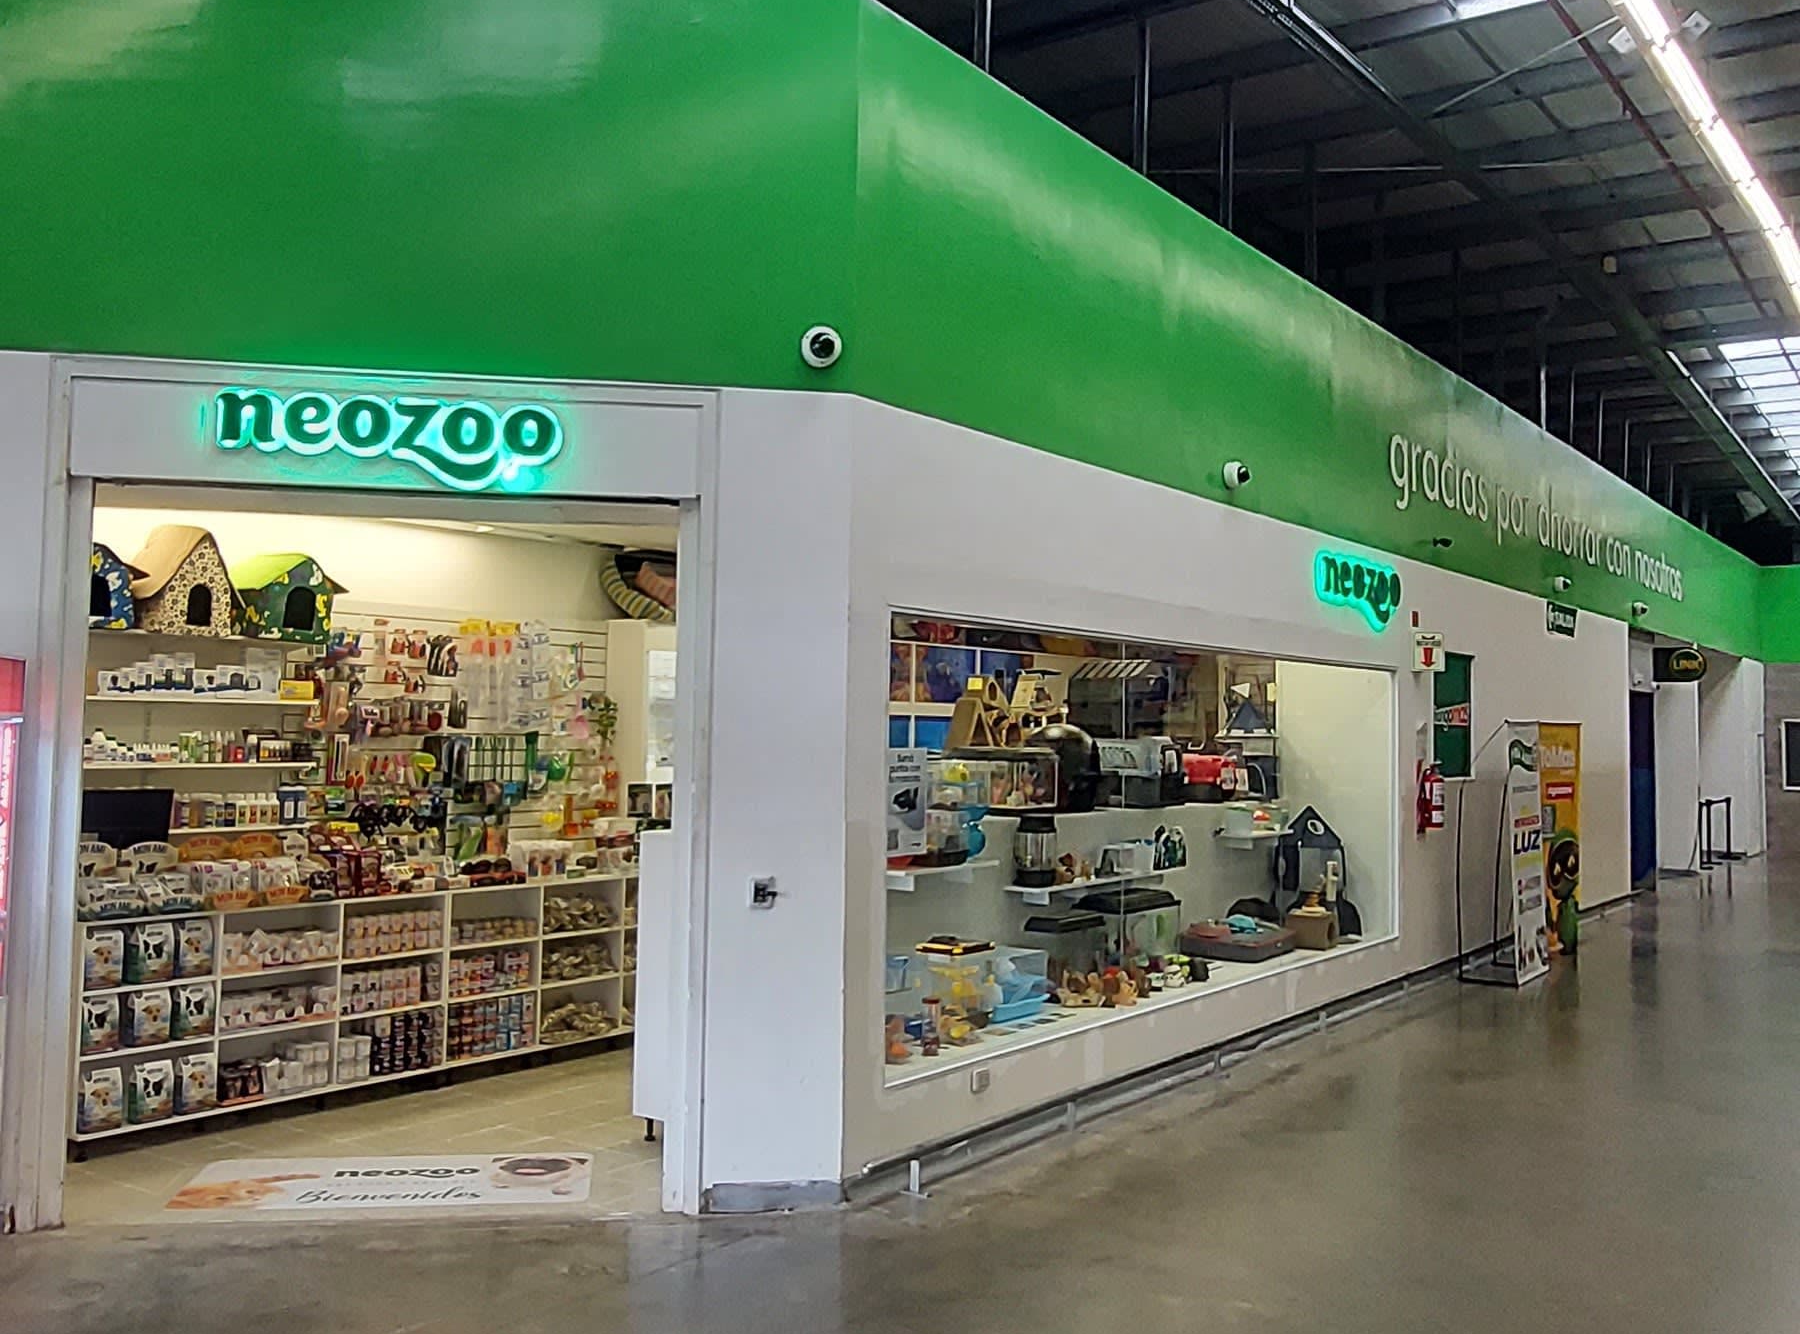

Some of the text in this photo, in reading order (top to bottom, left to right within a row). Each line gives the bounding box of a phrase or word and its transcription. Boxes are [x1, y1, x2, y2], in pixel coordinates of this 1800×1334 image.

[216, 391, 557, 482] neozoo
[1389, 434, 1684, 602] gracias por ahorrar con nosotros
[1321, 555, 1401, 625] neozoo
[1513, 829, 1540, 855] LUZ
[296, 1186, 480, 1204] Bienvenidos
[334, 1168, 480, 1178] neozoo
